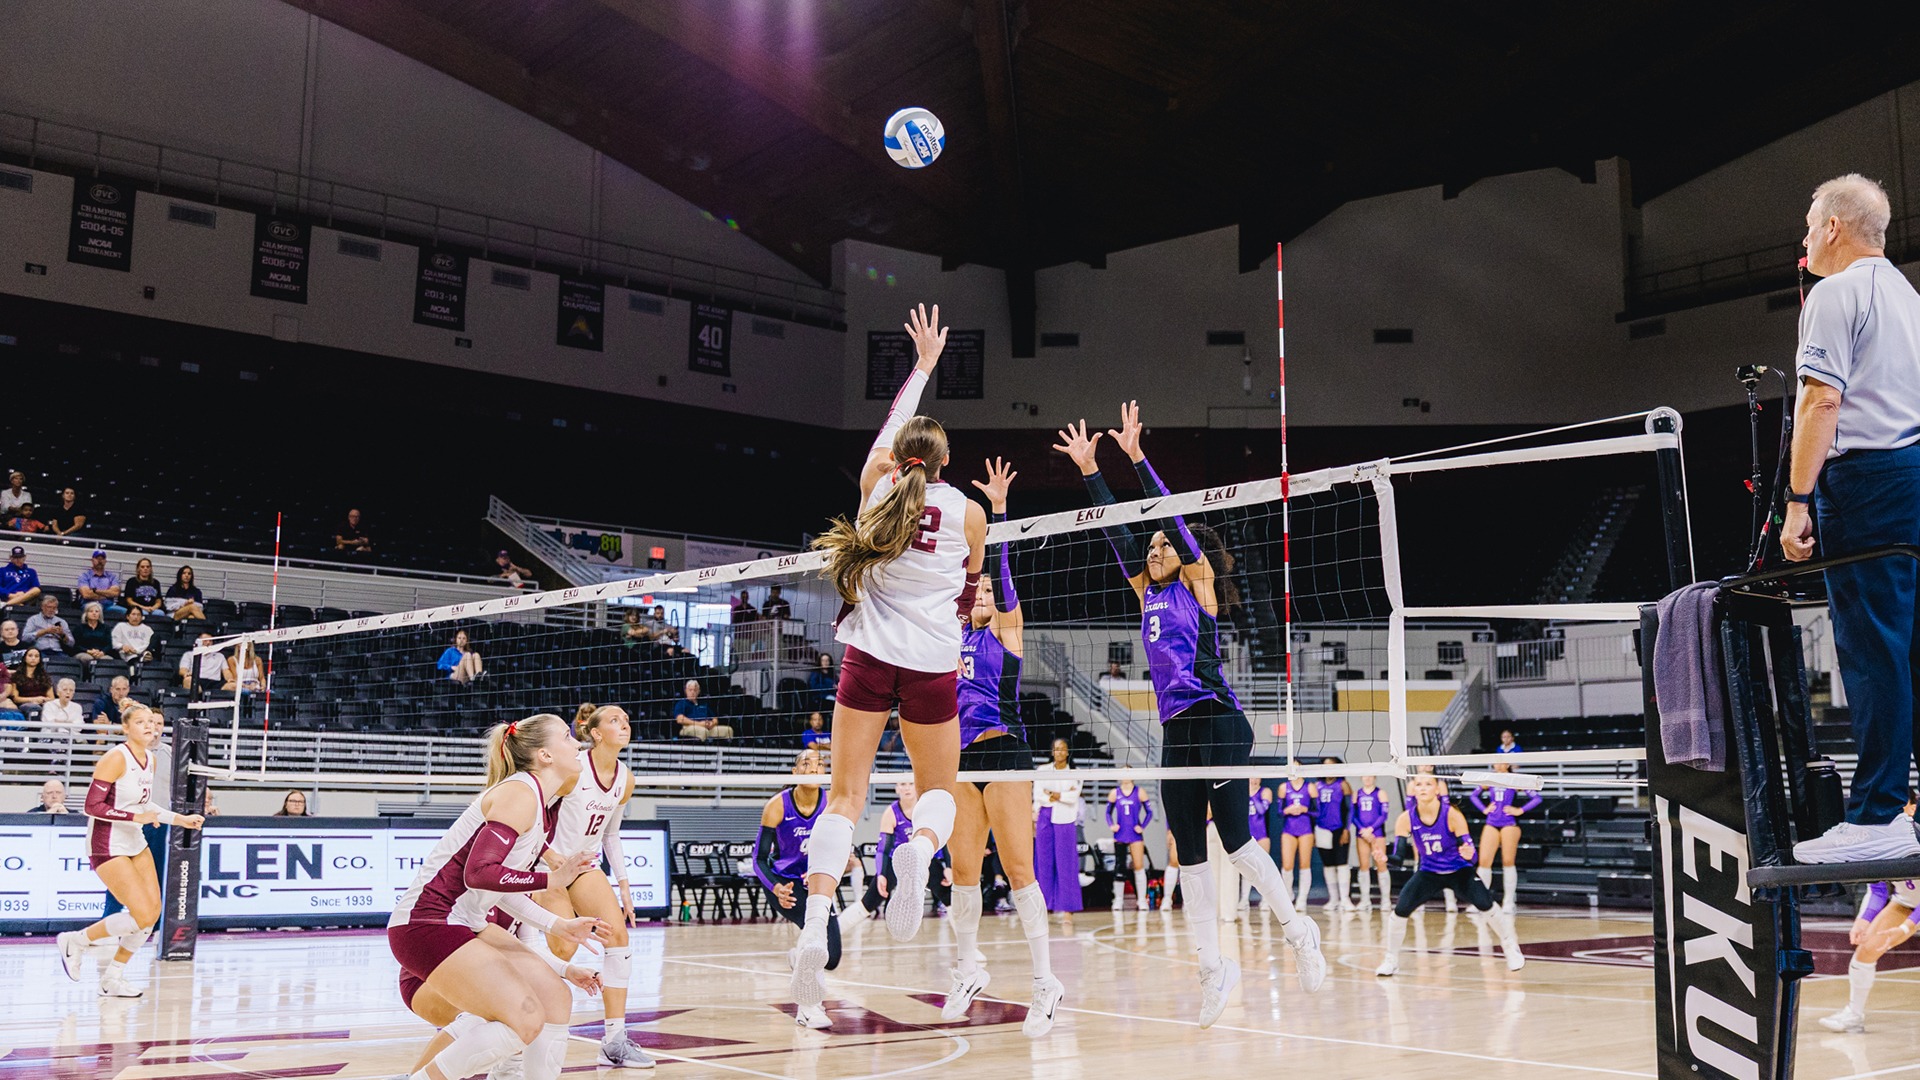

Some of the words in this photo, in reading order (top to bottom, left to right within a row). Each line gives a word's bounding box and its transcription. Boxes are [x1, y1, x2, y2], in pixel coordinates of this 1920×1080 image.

[920, 123, 940, 155] molten
[95, 189, 113, 199] OVC
[80, 204, 127, 219] CHAMPIONS
[80, 220, 125, 237] 2004-05
[273, 226, 292, 236] OVC
[87, 237, 113, 249] NCAA
[261, 240, 304, 254] CHAMPIONS
[78, 245, 122, 259] TOURNAMENT
[261, 256, 301, 270] 2006-07
[435, 258, 452, 267] OVC
[268, 272, 292, 282] NCAA
[423, 269, 462, 282] CHAMPIONS
[260, 279, 301, 292] TOURNAMENT
[424, 289, 458, 303] 2013-14
[430, 304, 451, 314] NCAA
[562, 300, 601, 313] CHAMPIONS
[422, 311, 458, 323] TOURNAMENT
[698, 324, 723, 350] 40
[1204, 486, 1238, 502] EKU
[1076, 507, 1106, 522] EKU
[601, 535, 621, 553] 811
[778, 555, 799, 567] EKU
[699, 567, 718, 578] EKU
[627, 579, 645, 589] EKU
[563, 589, 580, 599] EKU
[504, 597, 519, 607] EKU
[1148, 615, 1161, 643] 3
[138, 788, 151, 804] 21
[584, 813, 606, 836] 12
[689, 844, 714, 855] EKU
[729, 844, 753, 855] EKU
[1424, 841, 1443, 856] 14
[0, 856, 32, 871] O.
[59, 857, 93, 871] TH
[201, 843, 324, 880] LEN
[333, 856, 374, 870] CO.
[395, 857, 424, 870] TH
[180, 860, 189, 888] sports
[499, 872, 535, 885] Colonels
[201, 884, 260, 899] NC
[631, 890, 653, 901] 1939
[178, 887, 188, 920] imports
[346, 895, 373, 906] 1939
[1679, 804, 1760, 1080] EKU
